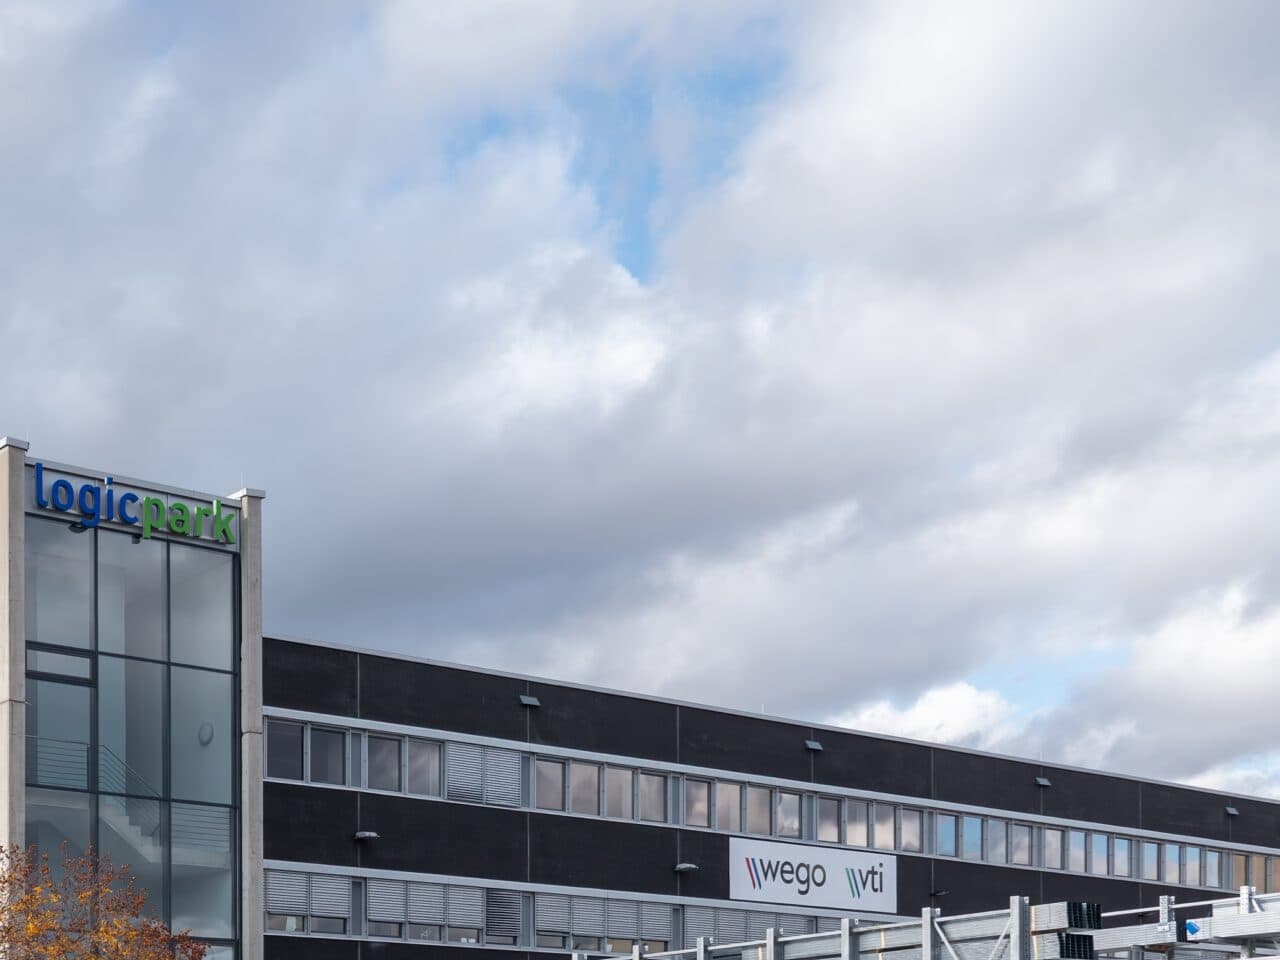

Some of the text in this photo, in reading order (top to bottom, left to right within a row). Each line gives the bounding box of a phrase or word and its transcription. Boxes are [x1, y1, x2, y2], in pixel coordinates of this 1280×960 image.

[35, 462, 236, 545] logicpark
[759, 857, 884, 895] wego vti
